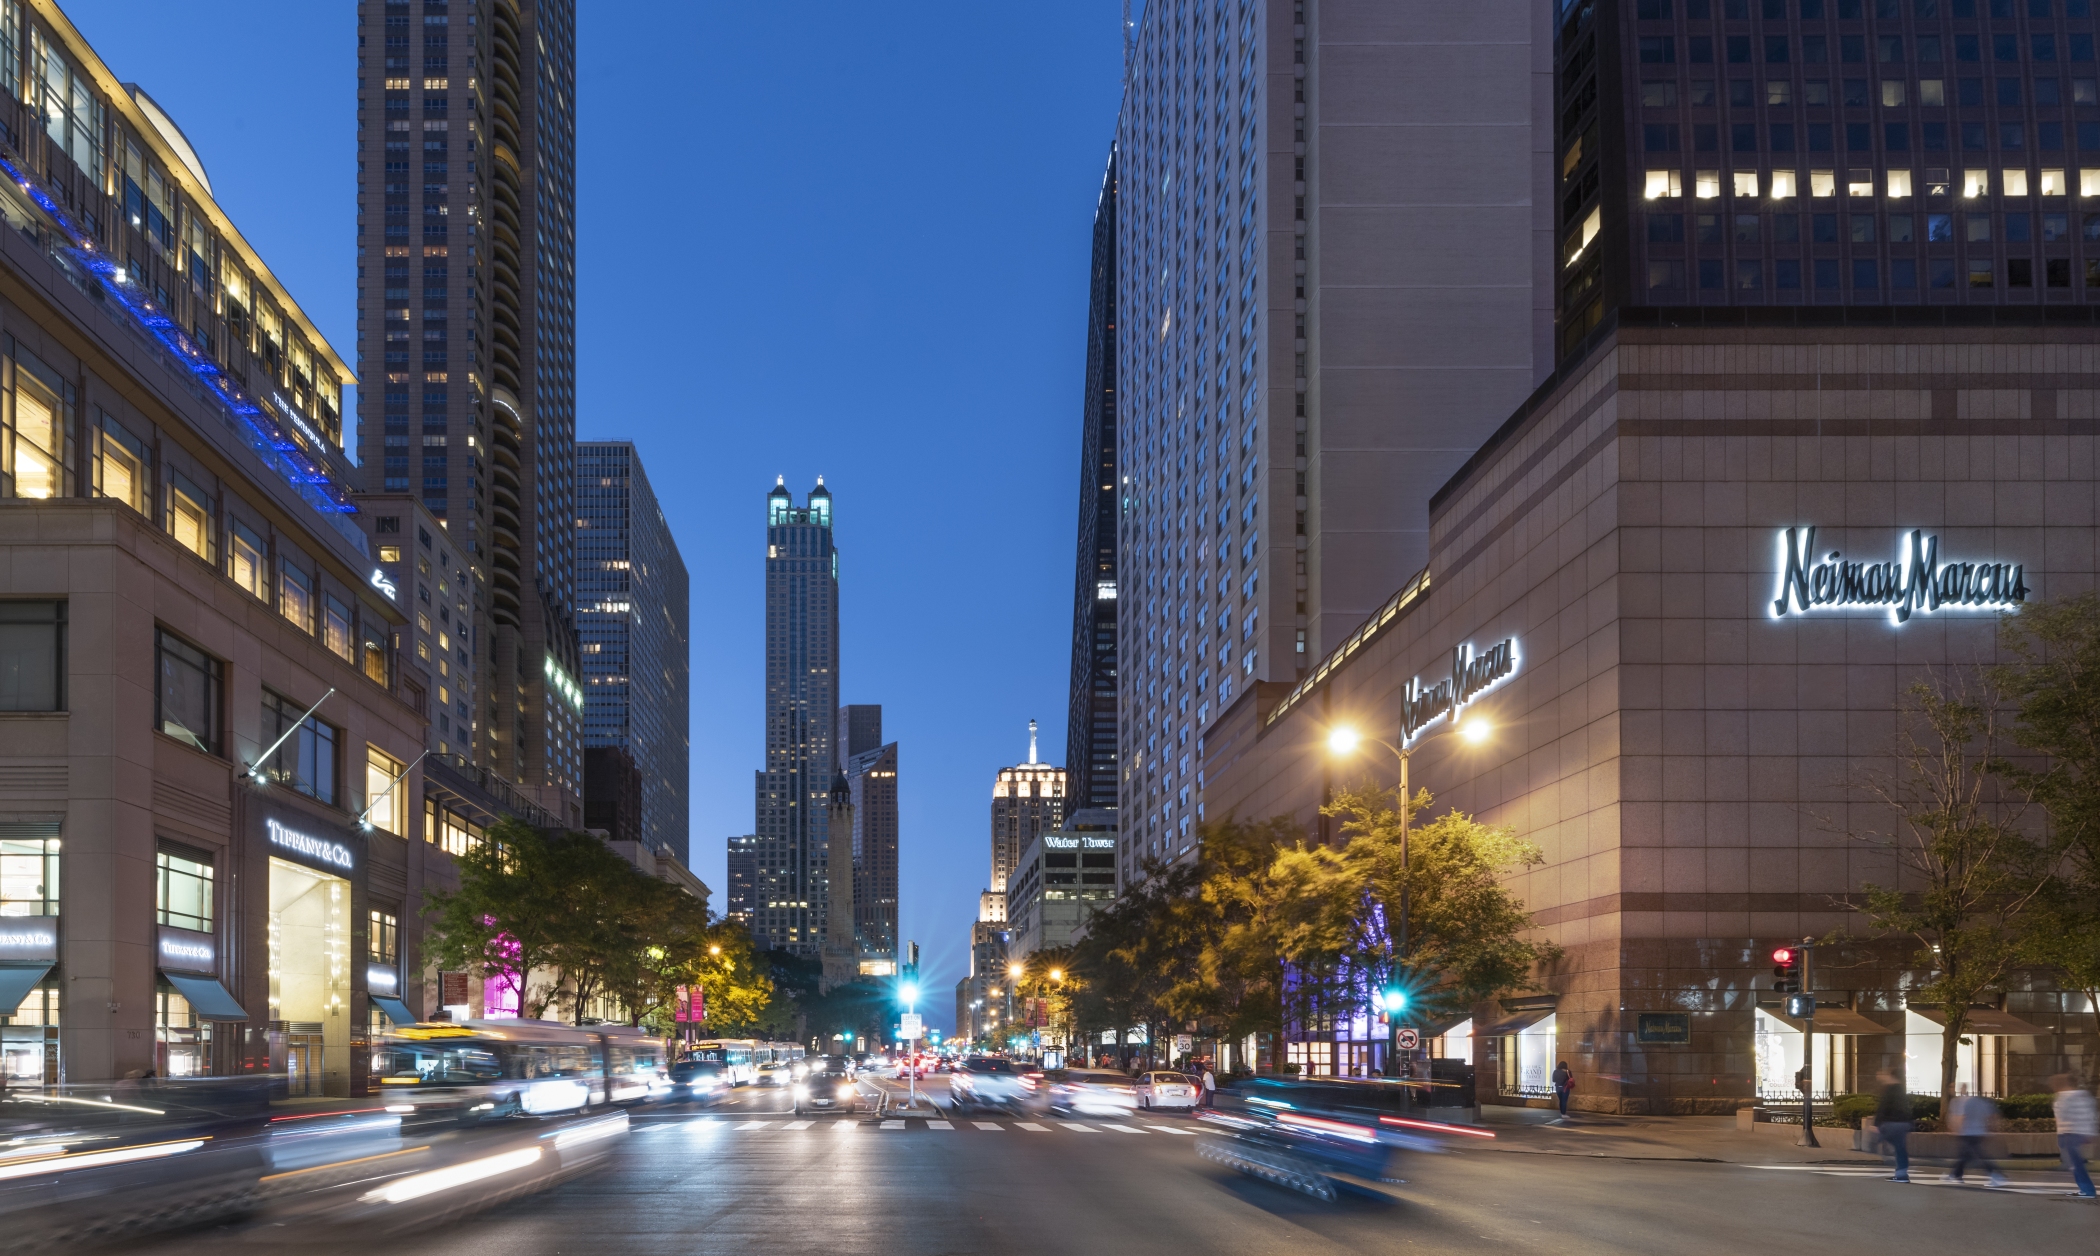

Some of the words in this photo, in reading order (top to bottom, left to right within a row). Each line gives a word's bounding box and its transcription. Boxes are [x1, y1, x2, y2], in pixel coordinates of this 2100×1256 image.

[1772, 525, 1904, 617] Neiman
[1894, 528, 2031, 624] Marcus
[1447, 637, 1518, 723] Marcus
[1044, 836, 1079, 848] Water
[1081, 836, 1115, 848] Tower
[1179, 1042, 1191, 1050] 30
